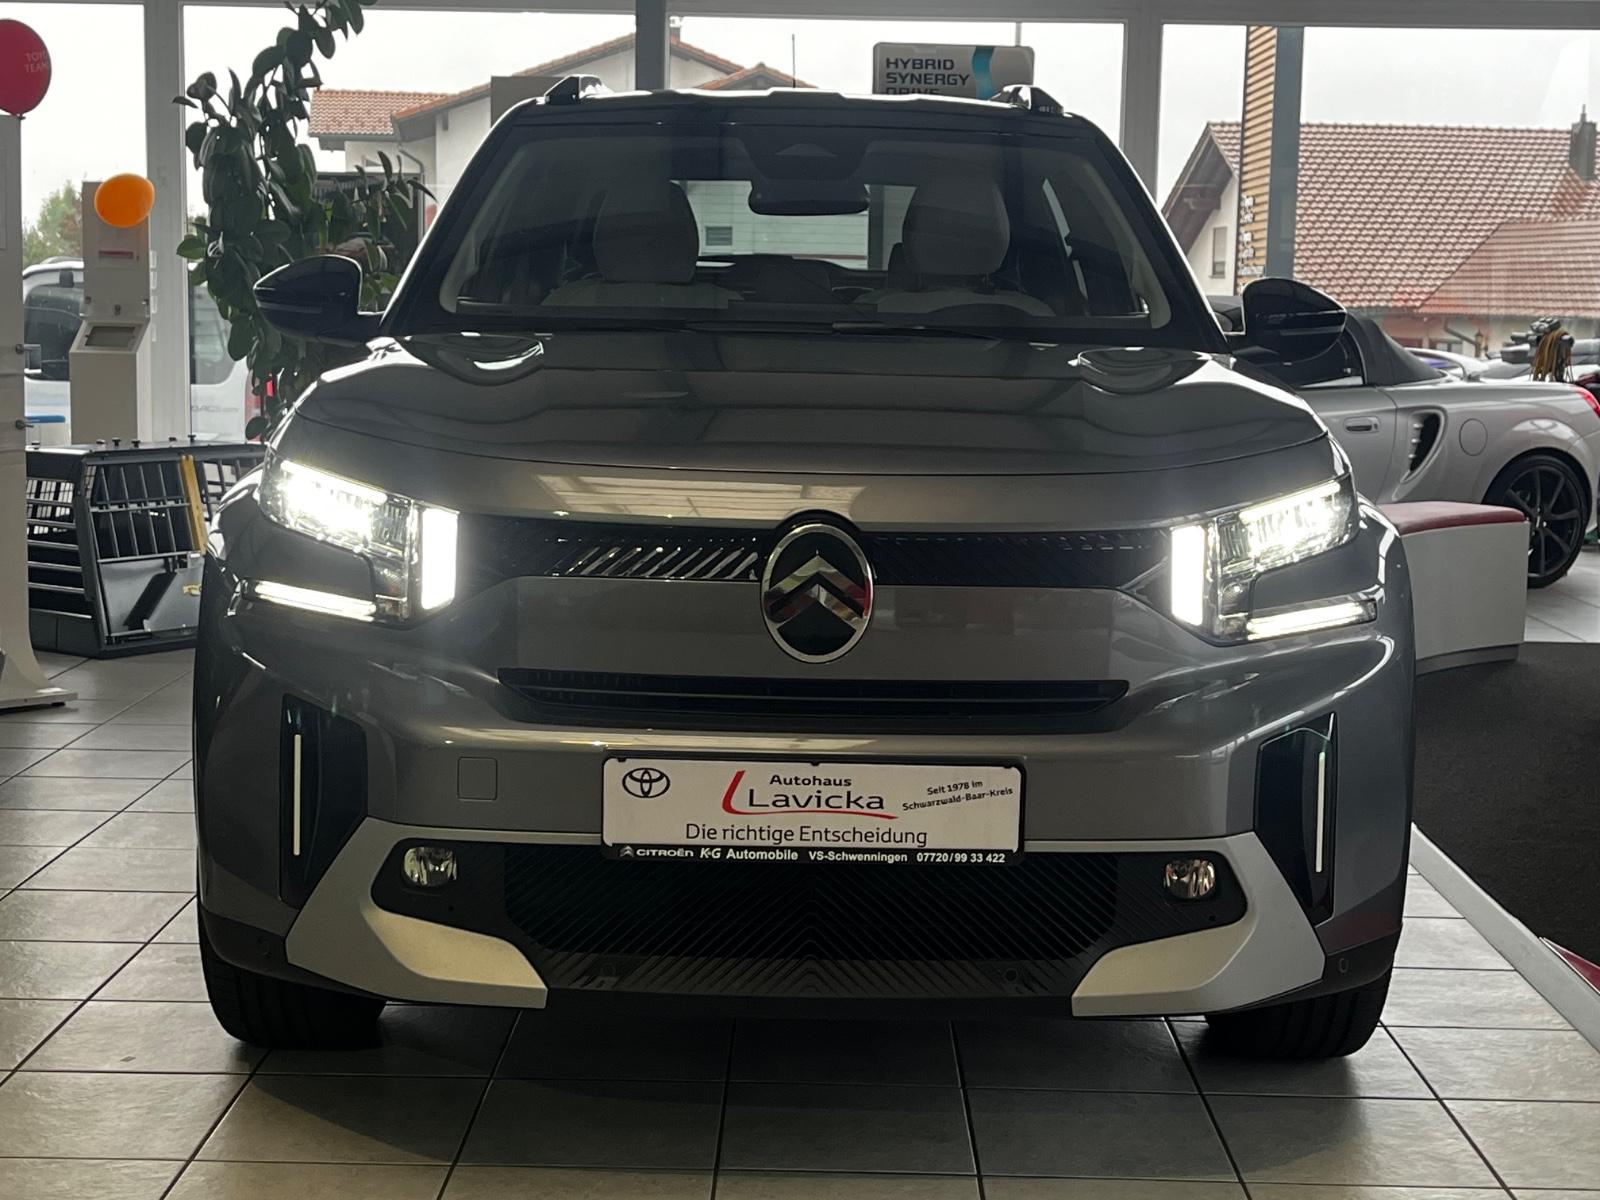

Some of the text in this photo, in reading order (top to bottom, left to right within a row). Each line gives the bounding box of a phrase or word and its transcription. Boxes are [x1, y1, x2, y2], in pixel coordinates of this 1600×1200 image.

[886, 57, 955, 70] HYBRID
[886, 72, 970, 86] SYNERGY
[769, 774, 852, 786] Autohaus
[927, 780, 984, 796] Seit 1978 im
[748, 788, 884, 809] Lavicka
[902, 787, 1013, 811] Schwarzwald-Baar-Kreis
[686, 823, 928, 848] Die richtige Entscheidung
[726, 848, 799, 861] Automobile
[808, 850, 908, 863] VS-Schwenningen
[916, 852, 968, 863] 07720/99
[970, 852, 984, 863] 33
[986, 853, 1006, 863] 422
